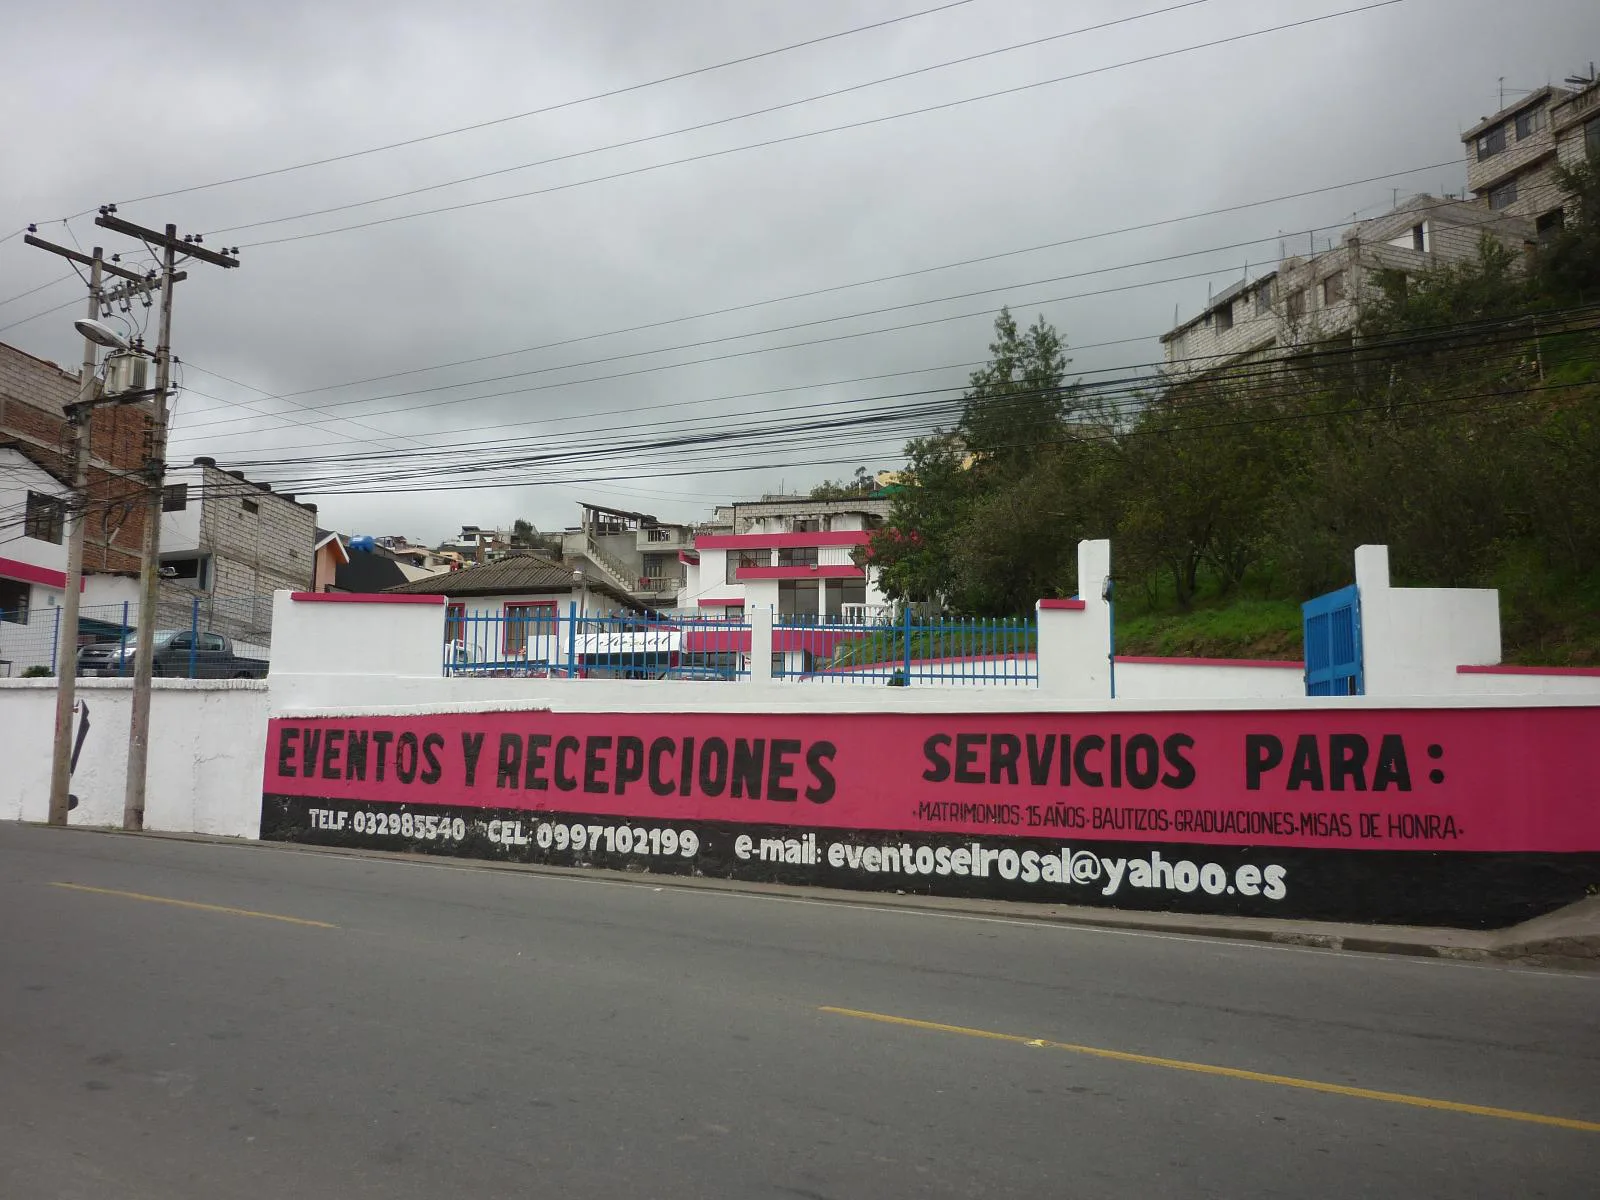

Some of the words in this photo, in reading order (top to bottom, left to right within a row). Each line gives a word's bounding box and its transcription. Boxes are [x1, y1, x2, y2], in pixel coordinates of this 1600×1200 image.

[278, 727, 445, 785] EVENTOS
[462, 732, 485, 788] Y
[496, 733, 837, 804] RECEPCIONES
[922, 733, 1197, 790] SERVICIOS
[1245, 733, 1445, 792] PARA:
[1359, 814, 1381, 838] DE
[536, 823, 700, 858] 0997102199
[734, 833, 822, 866] e-mail:
[827, 842, 1288, 901] eventoselrosal@yahoo.es
